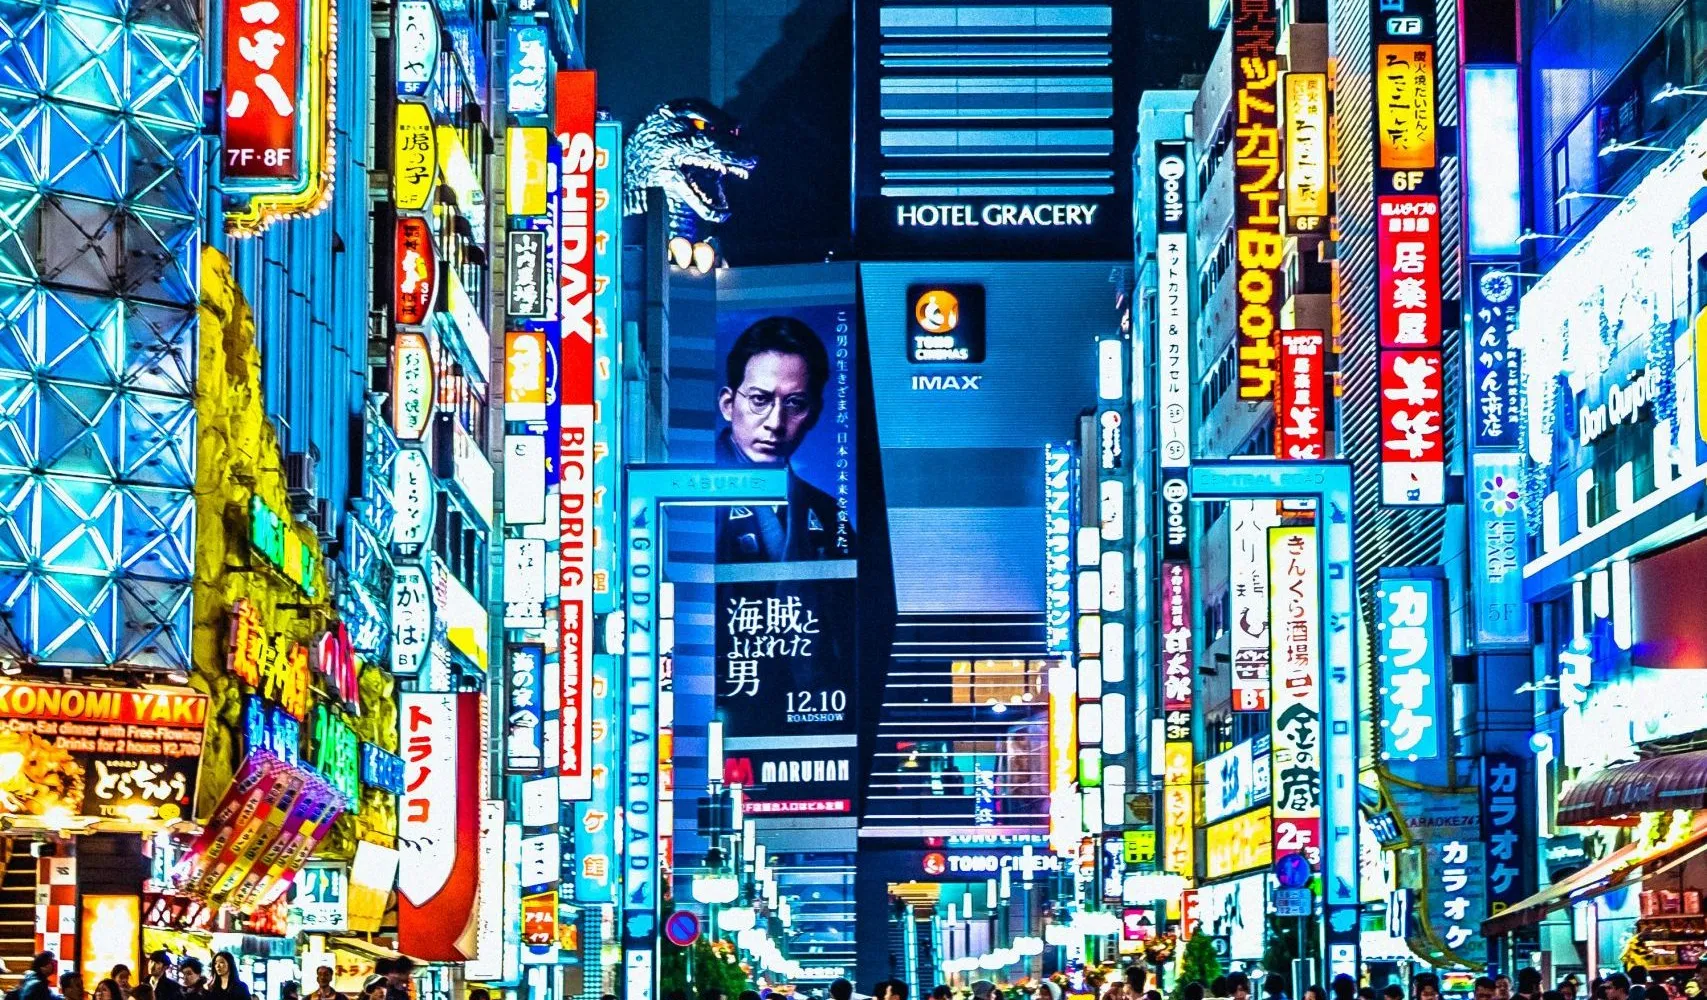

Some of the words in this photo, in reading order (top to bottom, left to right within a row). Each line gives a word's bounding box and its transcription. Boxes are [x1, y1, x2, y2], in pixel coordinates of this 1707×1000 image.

[1391, 20, 1418, 32] 7F
[404, 82, 420, 92] 5F
[1392, 172, 1423, 190] 6F
[897, 205, 978, 226] HOTEL
[982, 205, 1097, 226] GRACERY
[1297, 217, 1319, 230] 6F
[556, 132, 594, 344] SHIDAX
[1169, 325, 1178, 335] &
[912, 376, 979, 390] IMAX
[1580, 403, 1606, 447] Don
[561, 427, 584, 481] BIC
[560, 494, 584, 587] DRUG
[1503, 522, 1515, 571] IDOL
[727, 596, 819, 635] 海賊と
[1489, 604, 1516, 621] 5F
[632, 537, 651, 744] GODZILLA
[727, 634, 812, 658] よばれた
[399, 653, 417, 665] B1
[1389, 586, 1432, 751] カラオケ
[726, 660, 760, 697] 男
[131, 693, 206, 723] YAKI
[786, 690, 846, 713] 12.10
[1241, 690, 1269, 710] B1
[787, 713, 844, 722] ROADSHOW
[1167, 713, 1190, 725] 4F
[1167, 726, 1190, 739] 3F
[56, 737, 95, 751] Drinks
[97, 739, 115, 752] for
[115, 739, 125, 753] 2
[127, 740, 161, 754] hours
[1276, 702, 1321, 811] 金の蔵
[407, 706, 432, 822] トラノコ
[762, 760, 849, 782] MARUHAN
[632, 772, 650, 870] ROAD
[1489, 763, 1519, 893] カラオケ
[1277, 823, 1311, 851] 2F
[1442, 841, 1472, 948] カラオケ
